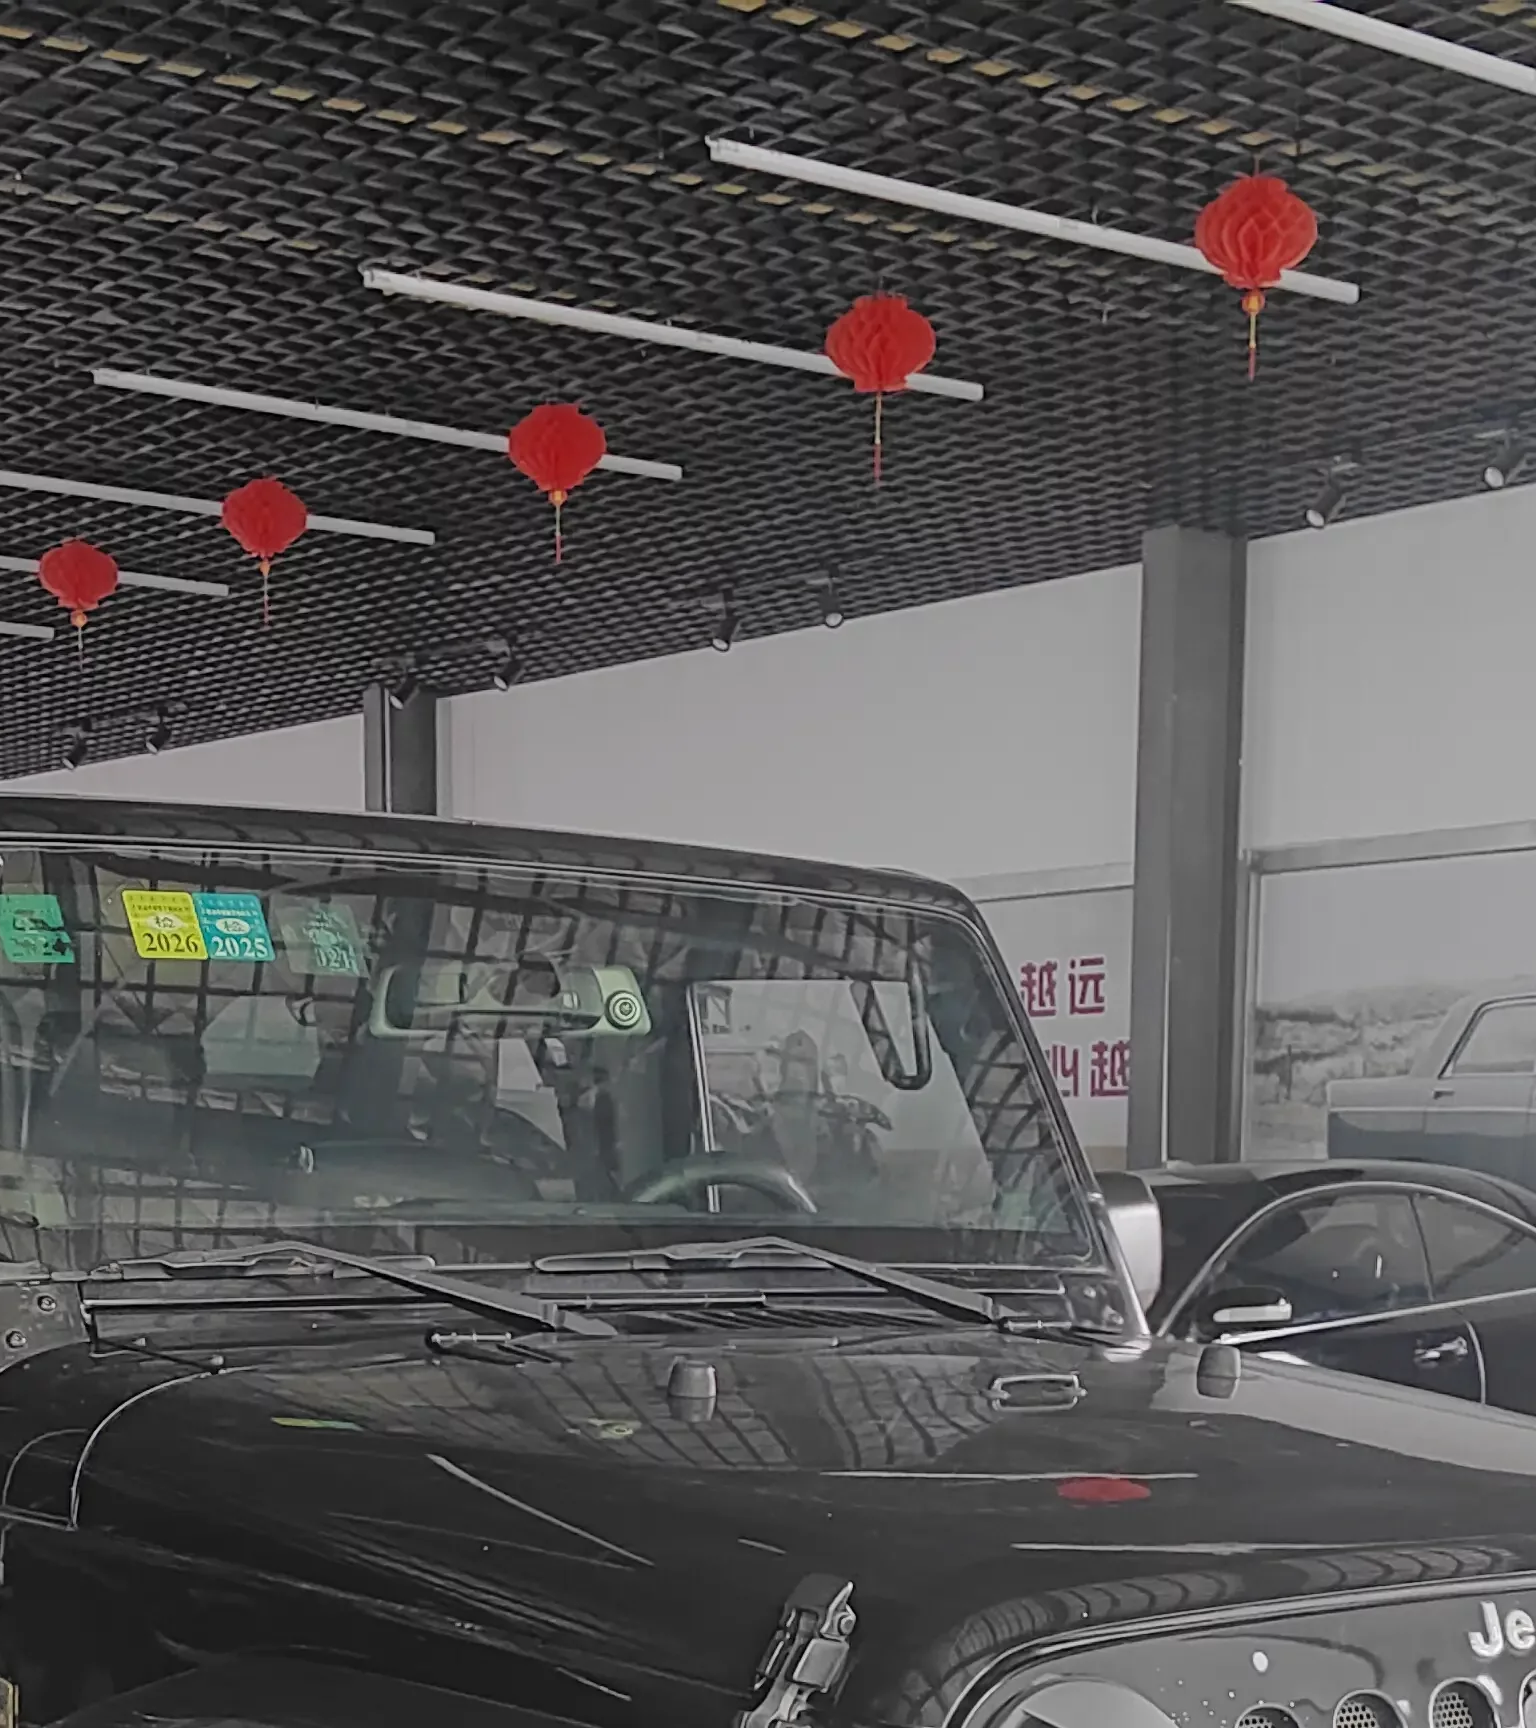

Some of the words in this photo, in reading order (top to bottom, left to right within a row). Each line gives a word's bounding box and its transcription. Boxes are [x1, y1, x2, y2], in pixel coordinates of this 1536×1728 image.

[142, 932, 200, 954] 2026
[211, 936, 269, 959] 2025
[1020, 957, 1106, 1018] 越远
